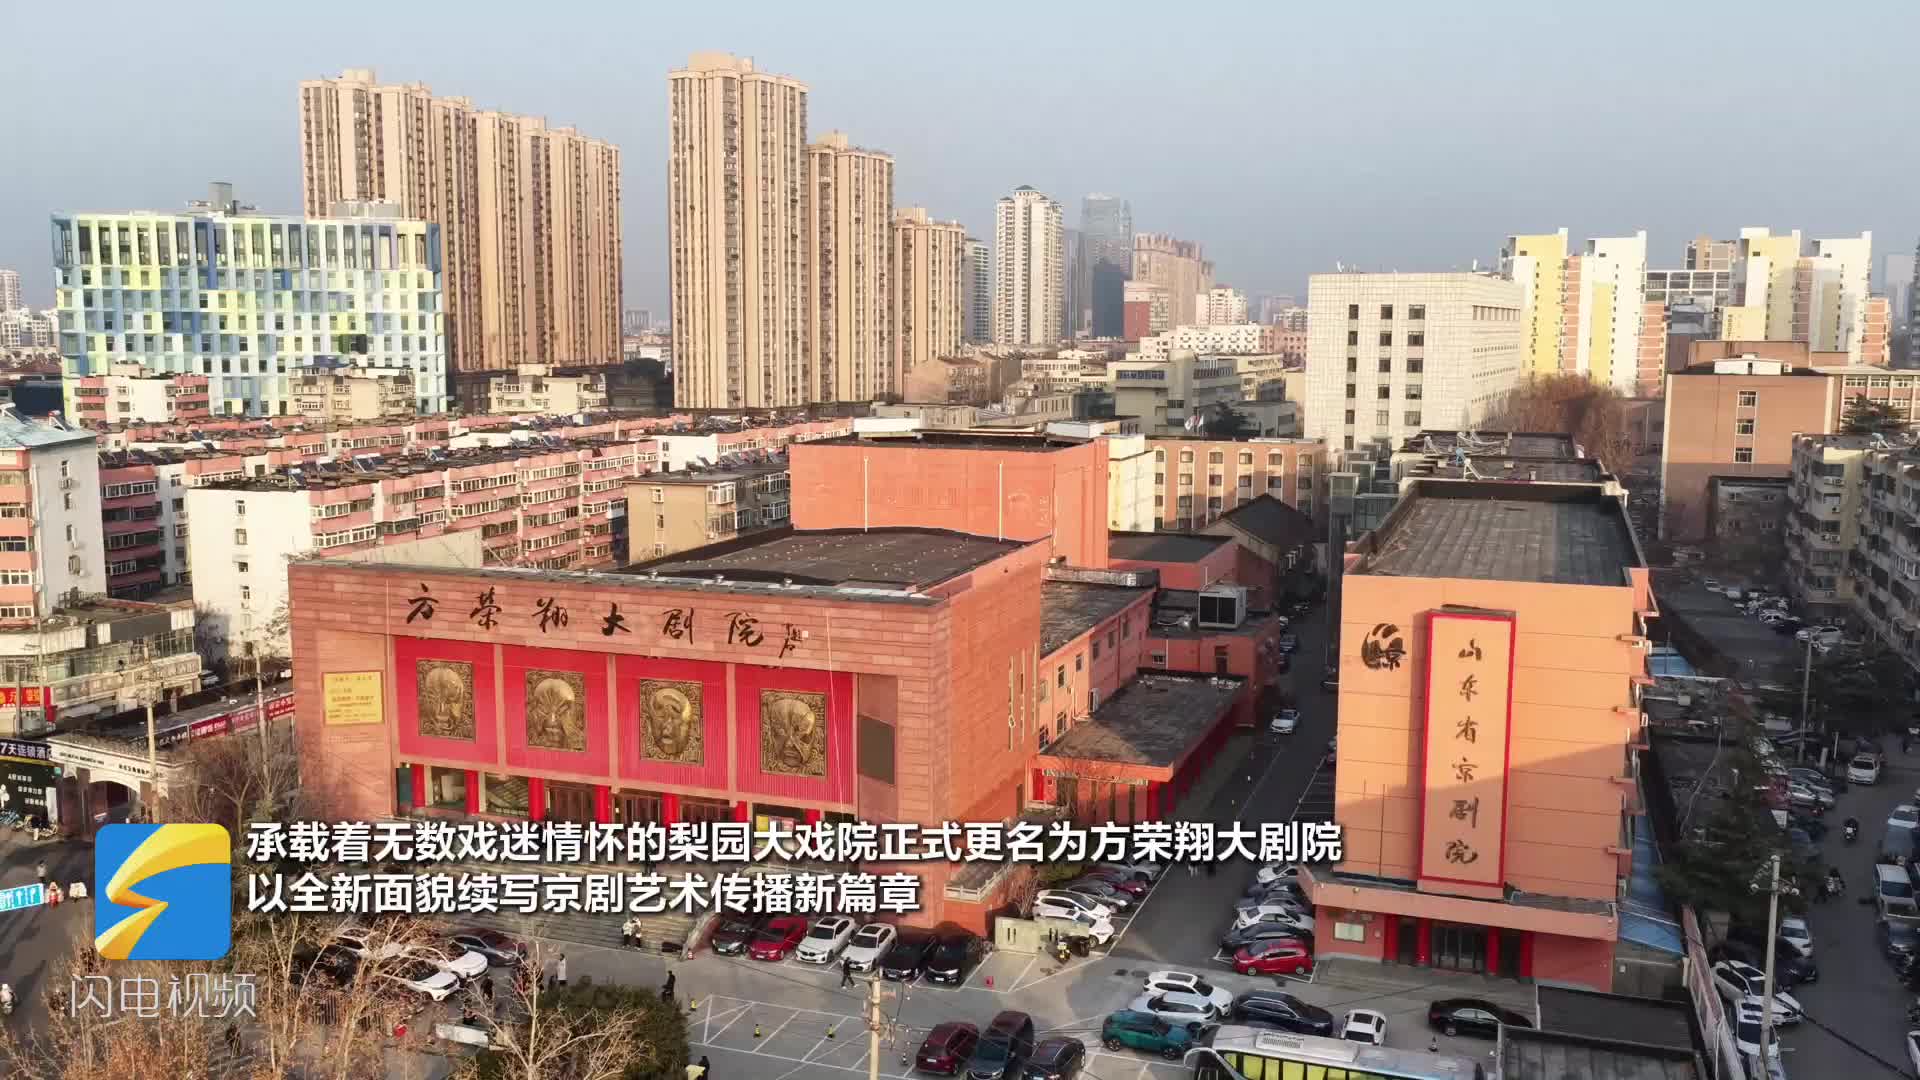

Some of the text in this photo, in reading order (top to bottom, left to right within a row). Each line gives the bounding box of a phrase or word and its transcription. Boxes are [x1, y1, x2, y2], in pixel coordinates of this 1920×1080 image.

[1445, 639, 1482, 864] 山东省京剧院
